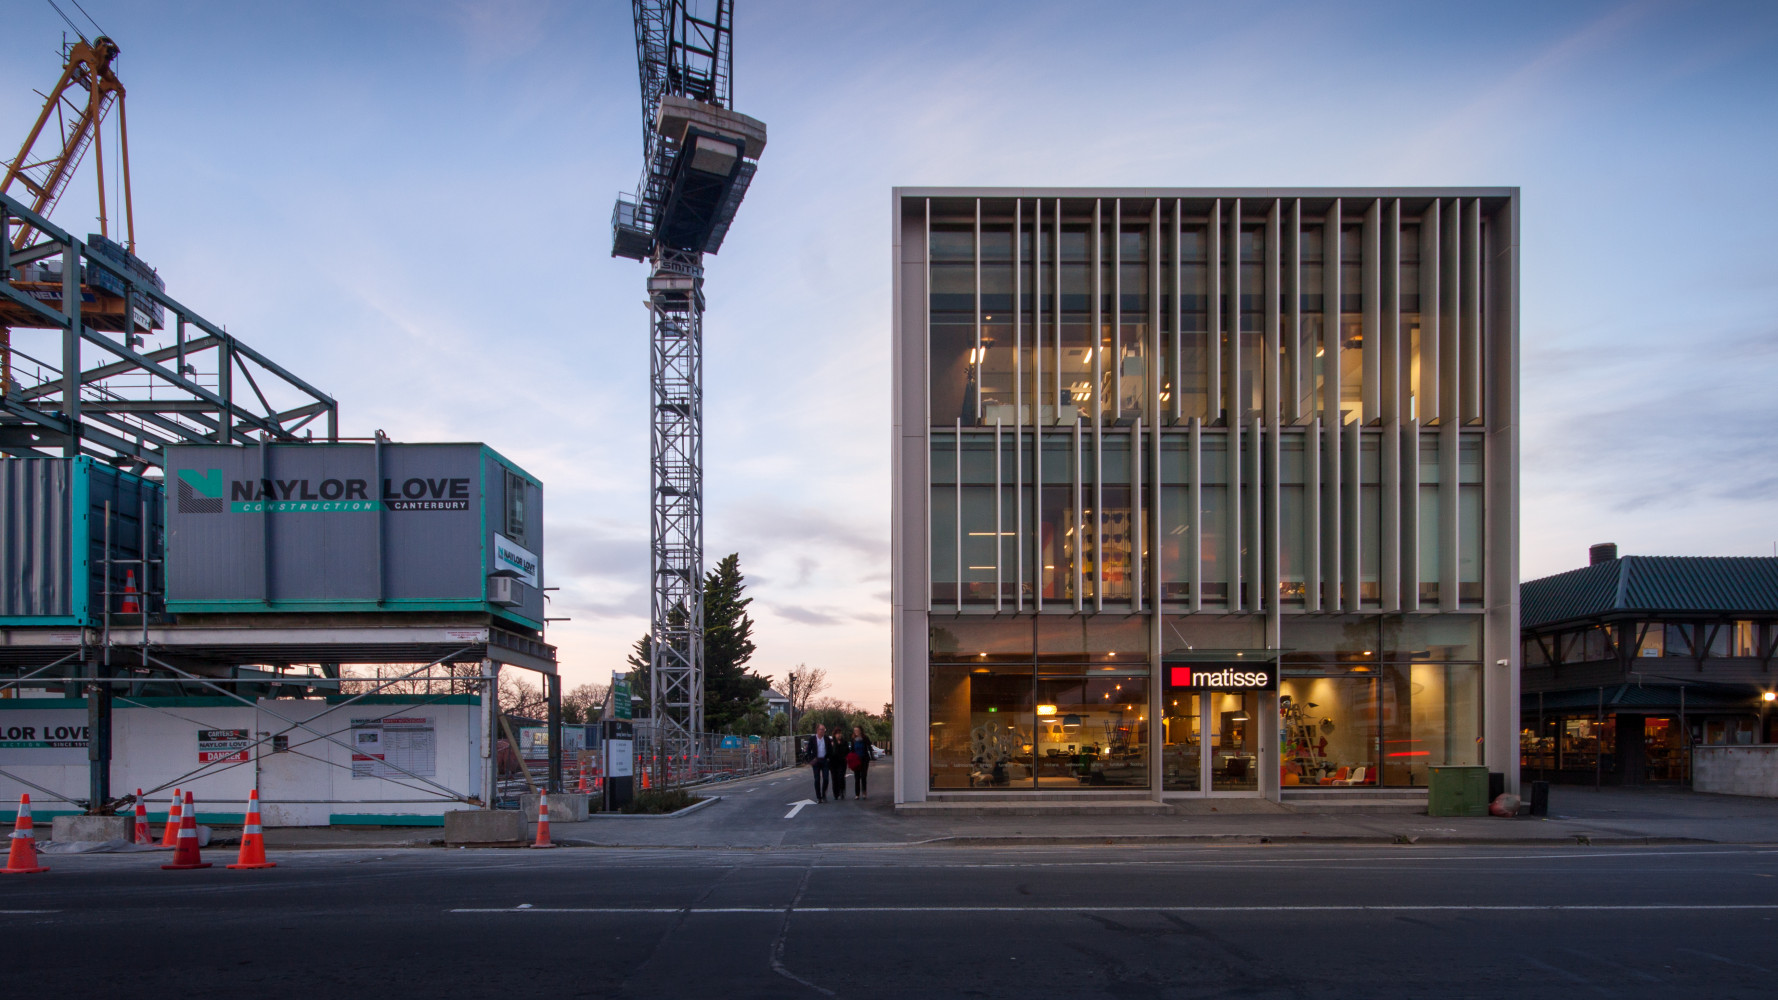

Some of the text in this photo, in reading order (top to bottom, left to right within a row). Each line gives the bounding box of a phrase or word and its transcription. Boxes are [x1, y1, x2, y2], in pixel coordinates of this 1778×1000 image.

[231, 478, 470, 501] NAYLOR LOVE
[242, 503, 372, 511] CONSTRUCTION
[503, 548, 523, 567] NAYLOR
[523, 559, 536, 573] LOVE
[1193, 668, 1268, 687] matisse
